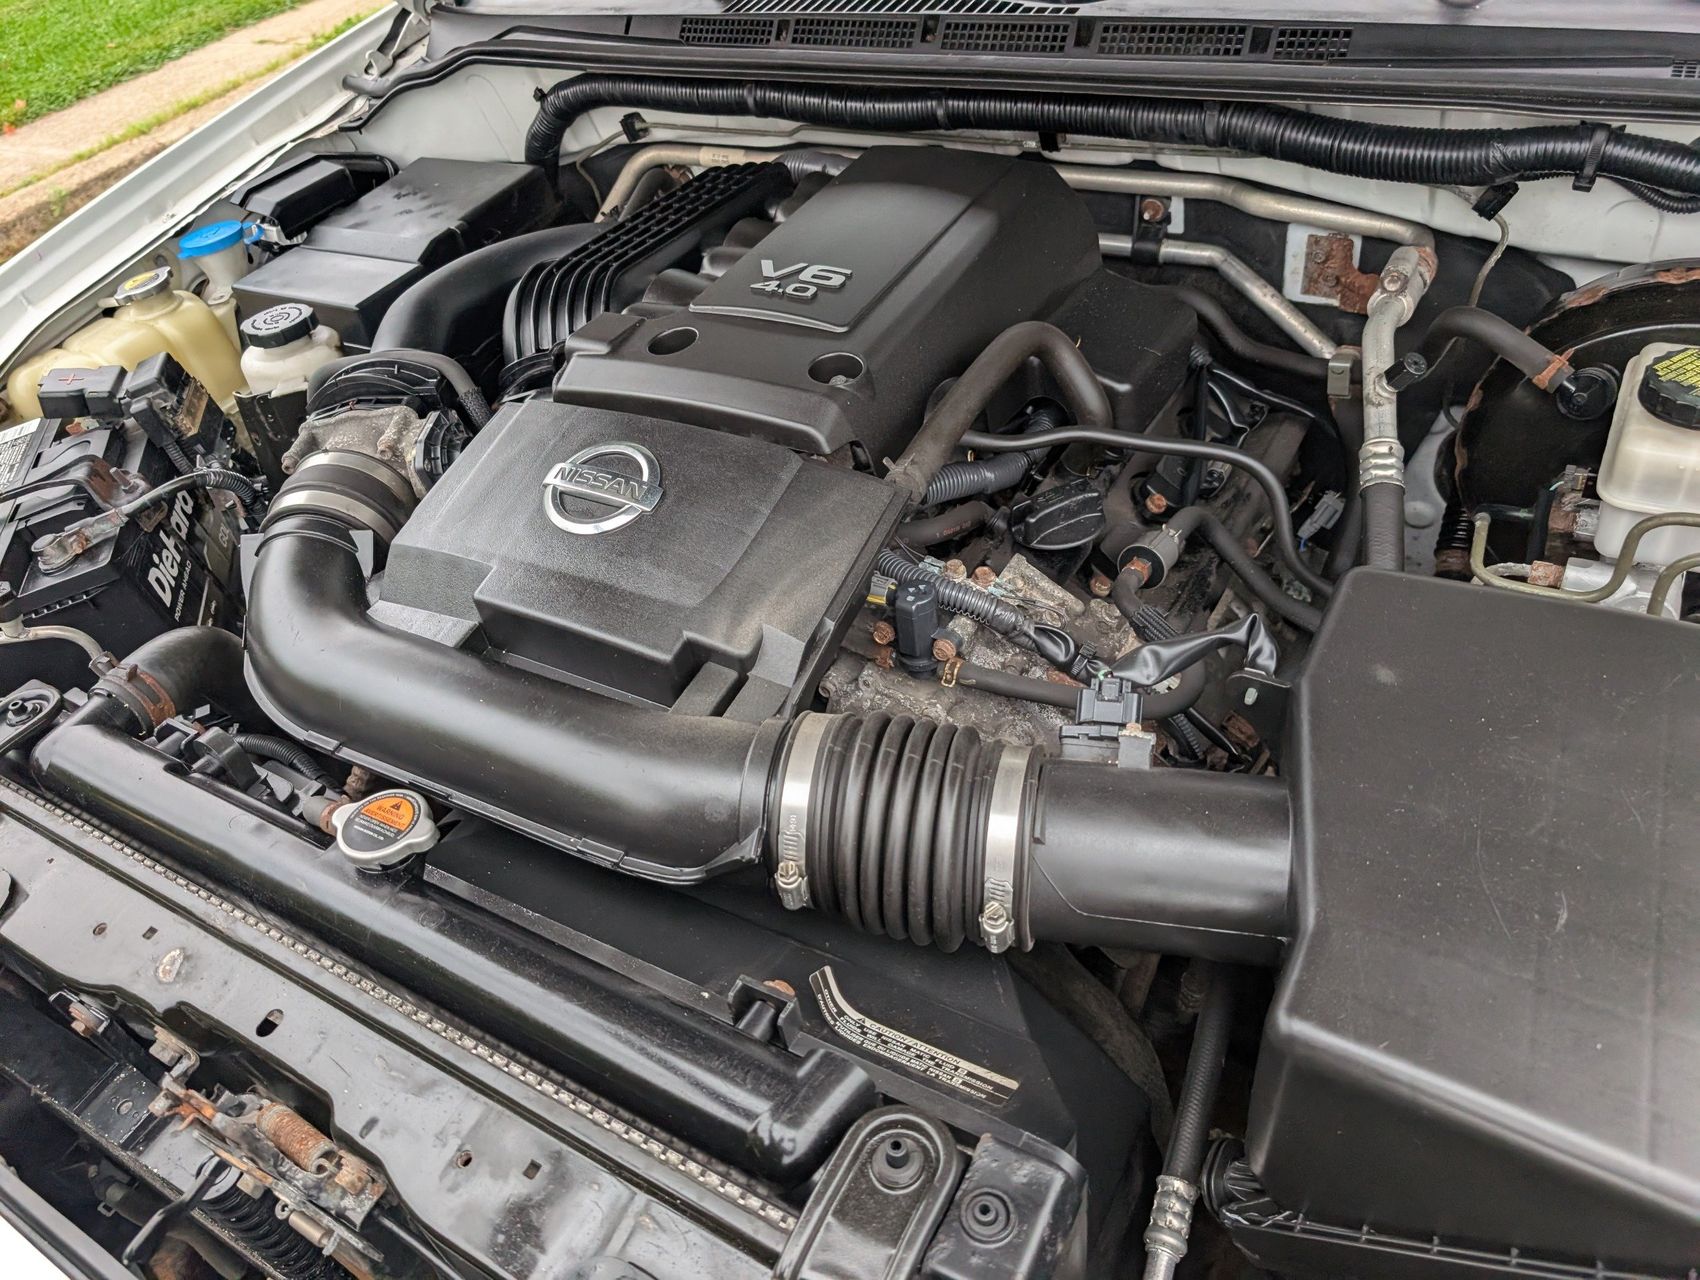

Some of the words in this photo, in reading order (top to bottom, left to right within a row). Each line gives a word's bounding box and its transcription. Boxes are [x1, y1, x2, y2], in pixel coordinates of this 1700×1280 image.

[749, 280, 818, 300] 4.0
[760, 259, 853, 289] V6
[553, 465, 648, 502] NISSAN
[174, 589, 186, 622] POWER
[182, 560, 192, 590] AHEAD
[376, 804, 405, 820] WARNING
[824, 988, 838, 1013] OTHER
[866, 1033, 882, 1043] WILL
[887, 1042, 917, 1057] DAMAGE
[922, 1057, 936, 1066] THE
[941, 1066, 994, 1091] TRANSMISSION
[843, 1015, 861, 1027] ONLY
[863, 1027, 878, 1036] USE
[880, 1035, 906, 1048] NISSAN
[909, 1047, 931, 1059] MATIC
[934, 1058, 956, 1069] FLUID
[869, 1023, 908, 1042] CAUTION
[912, 1042, 961, 1065] ATTENTION
[910, 1058, 929, 1069] MATIC
[928, 1067, 952, 1080] NISSAN
[926, 1070, 937, 1078] LA
